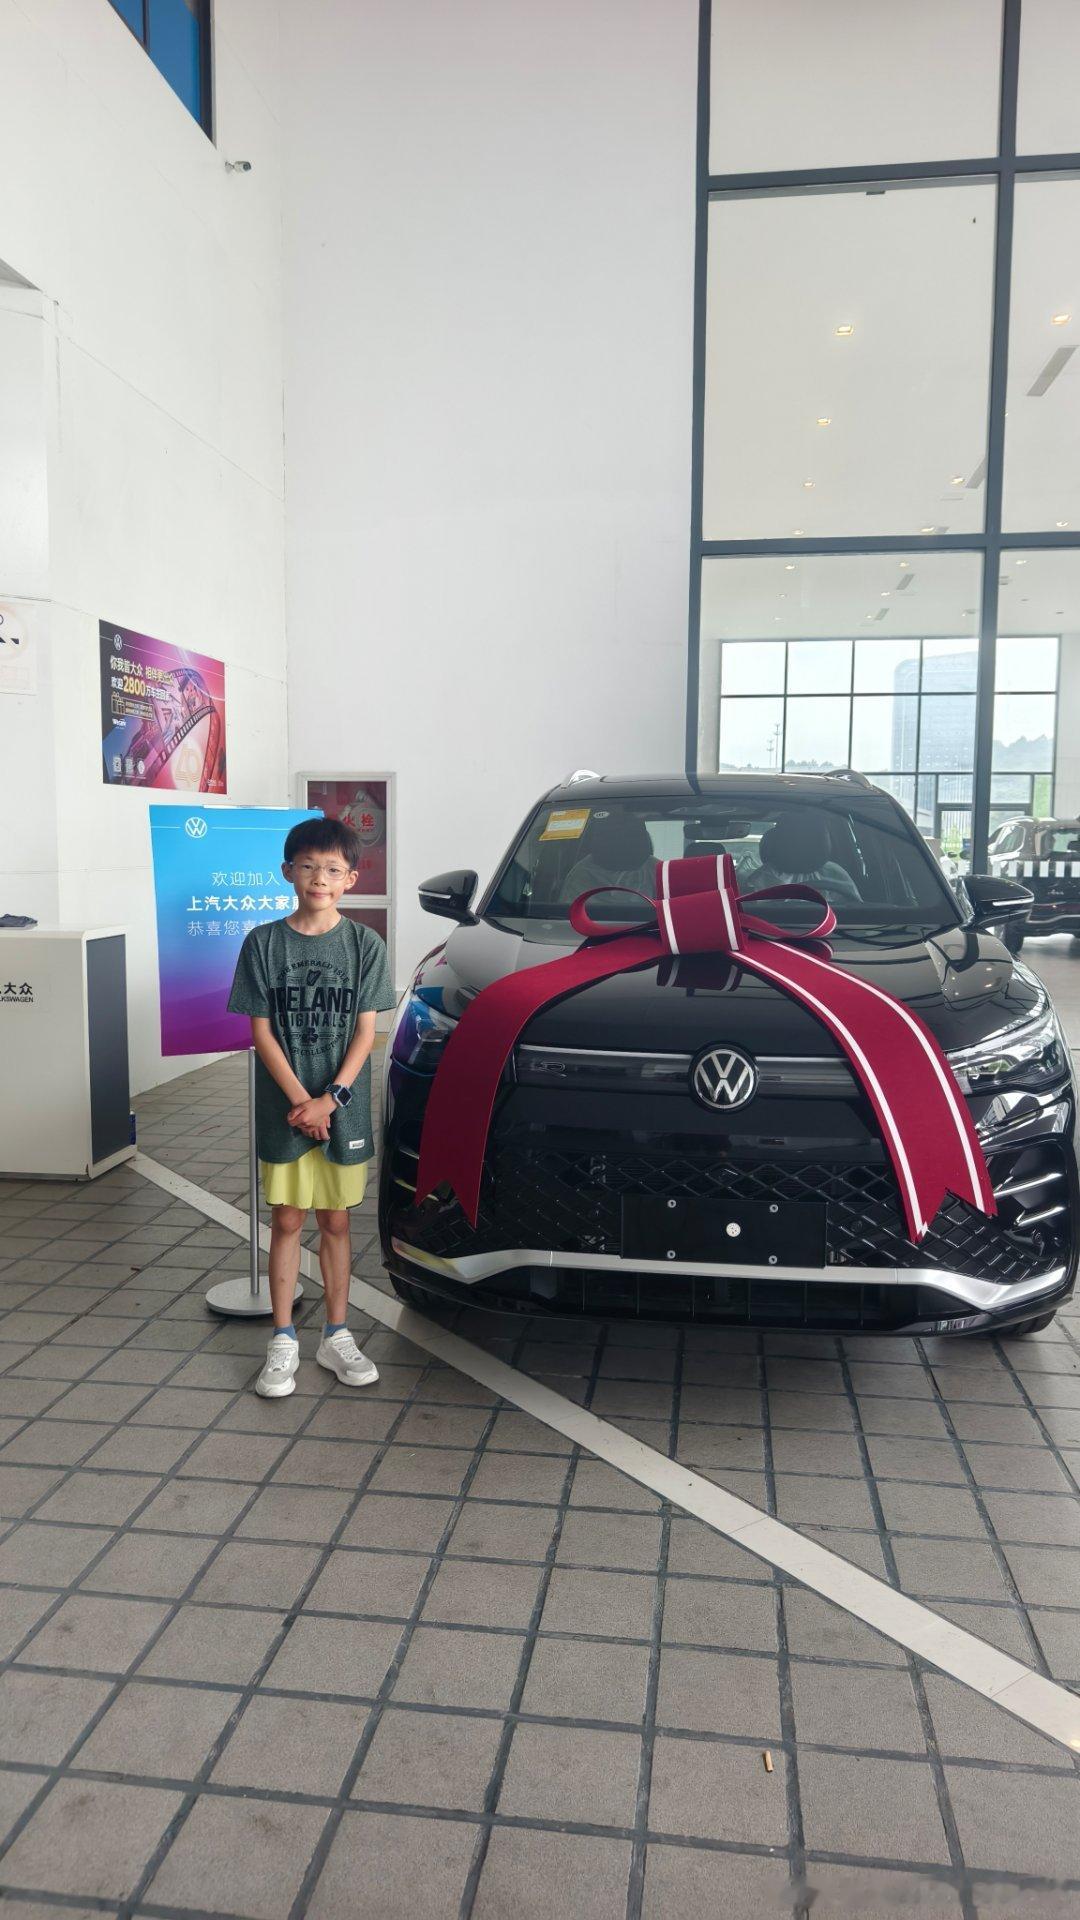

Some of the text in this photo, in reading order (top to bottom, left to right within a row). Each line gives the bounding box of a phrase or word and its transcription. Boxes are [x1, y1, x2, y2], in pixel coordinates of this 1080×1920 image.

[212, 871, 280, 887] 欢迎加入
[186, 919, 274, 937] 恭喜您喜
[291, 959, 333, 970] EMERALD
[333, 967, 350, 984] ISLE
